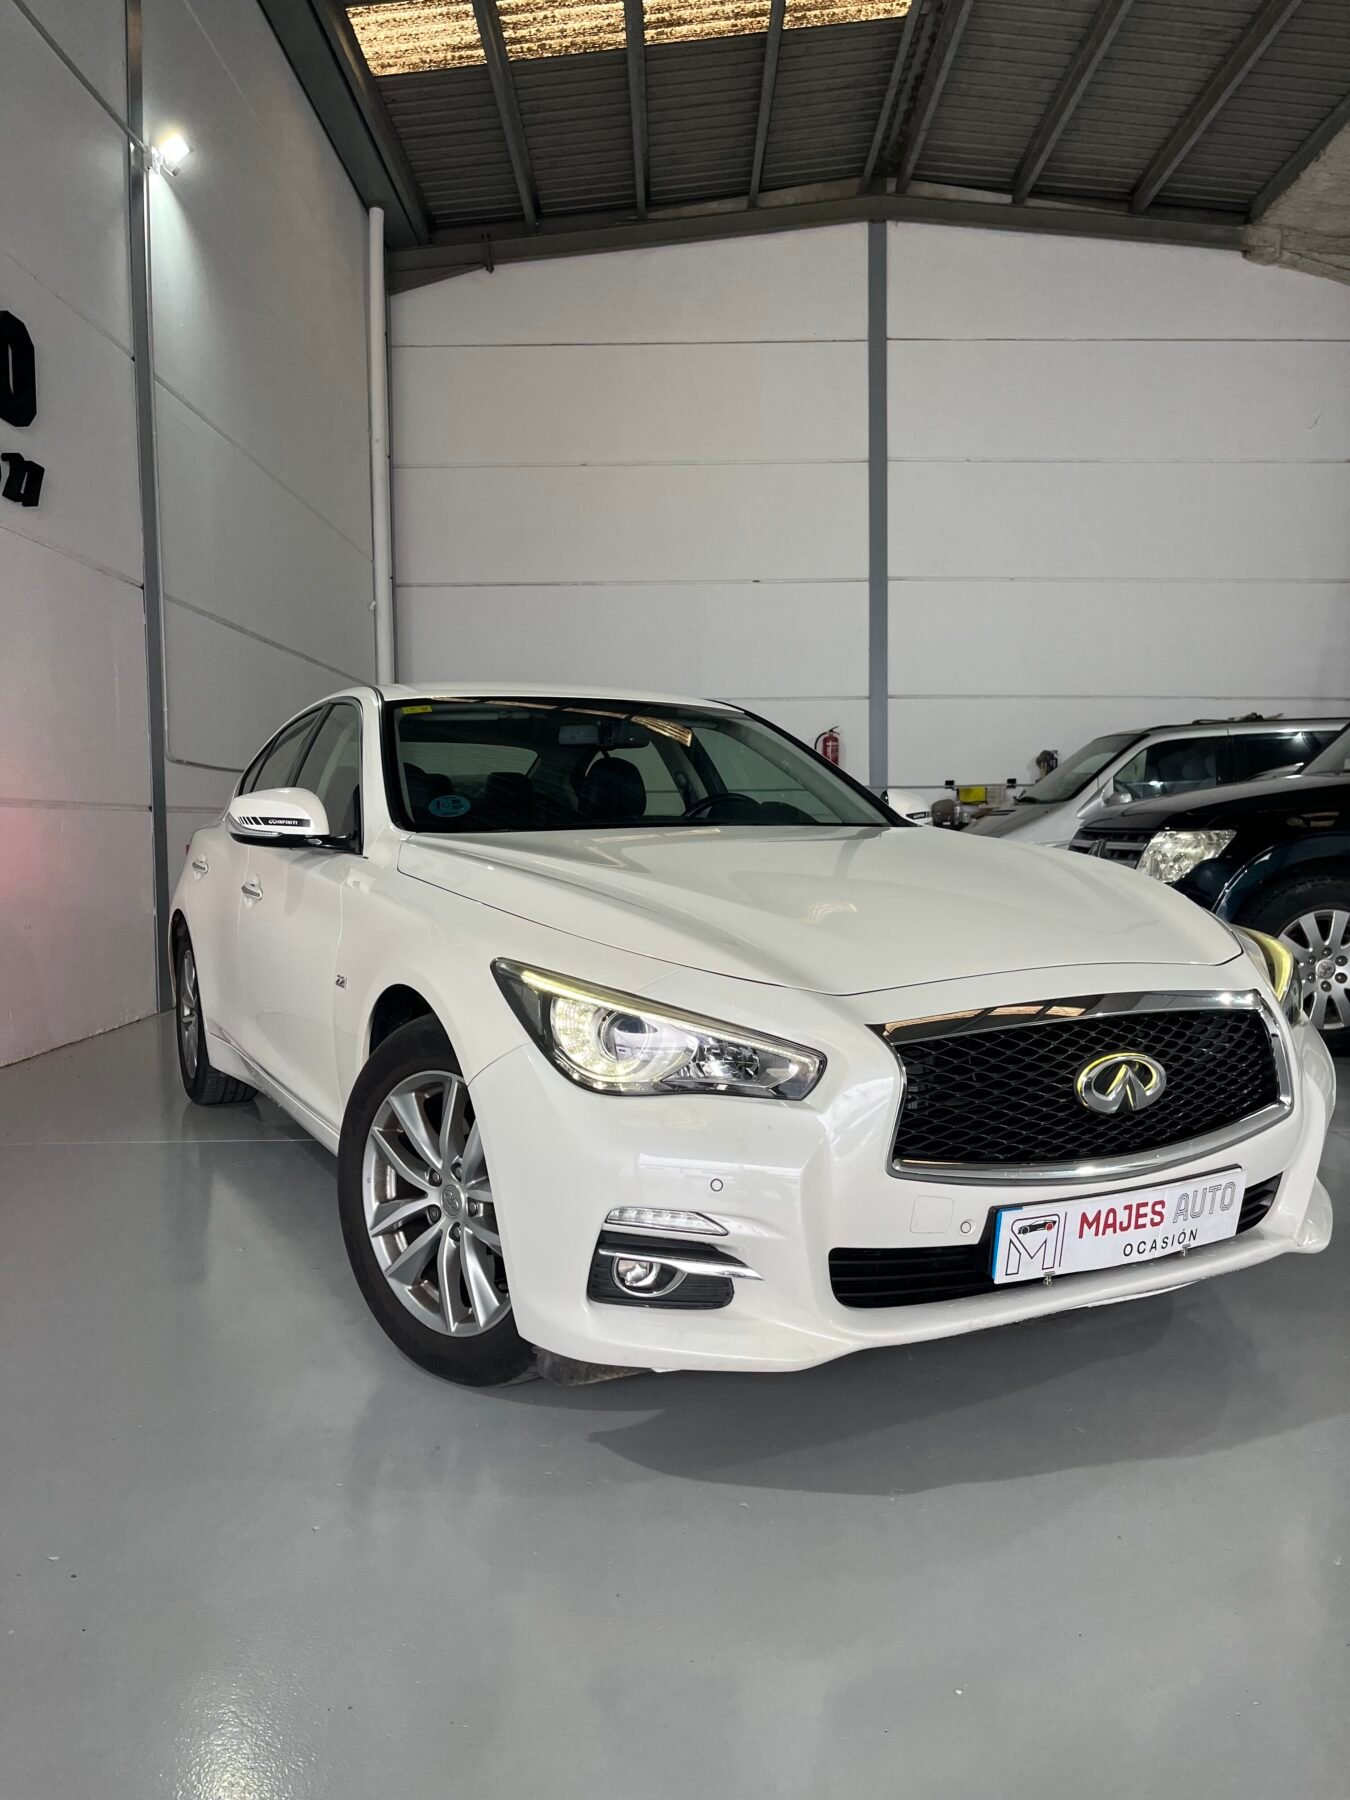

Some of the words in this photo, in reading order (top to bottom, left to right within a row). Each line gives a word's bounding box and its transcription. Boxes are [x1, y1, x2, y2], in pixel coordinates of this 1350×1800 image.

[1078, 1200, 1166, 1239] MAJES
[1172, 1181, 1237, 1224] AUTO
[1123, 1228, 1198, 1257] OCASIÓN
